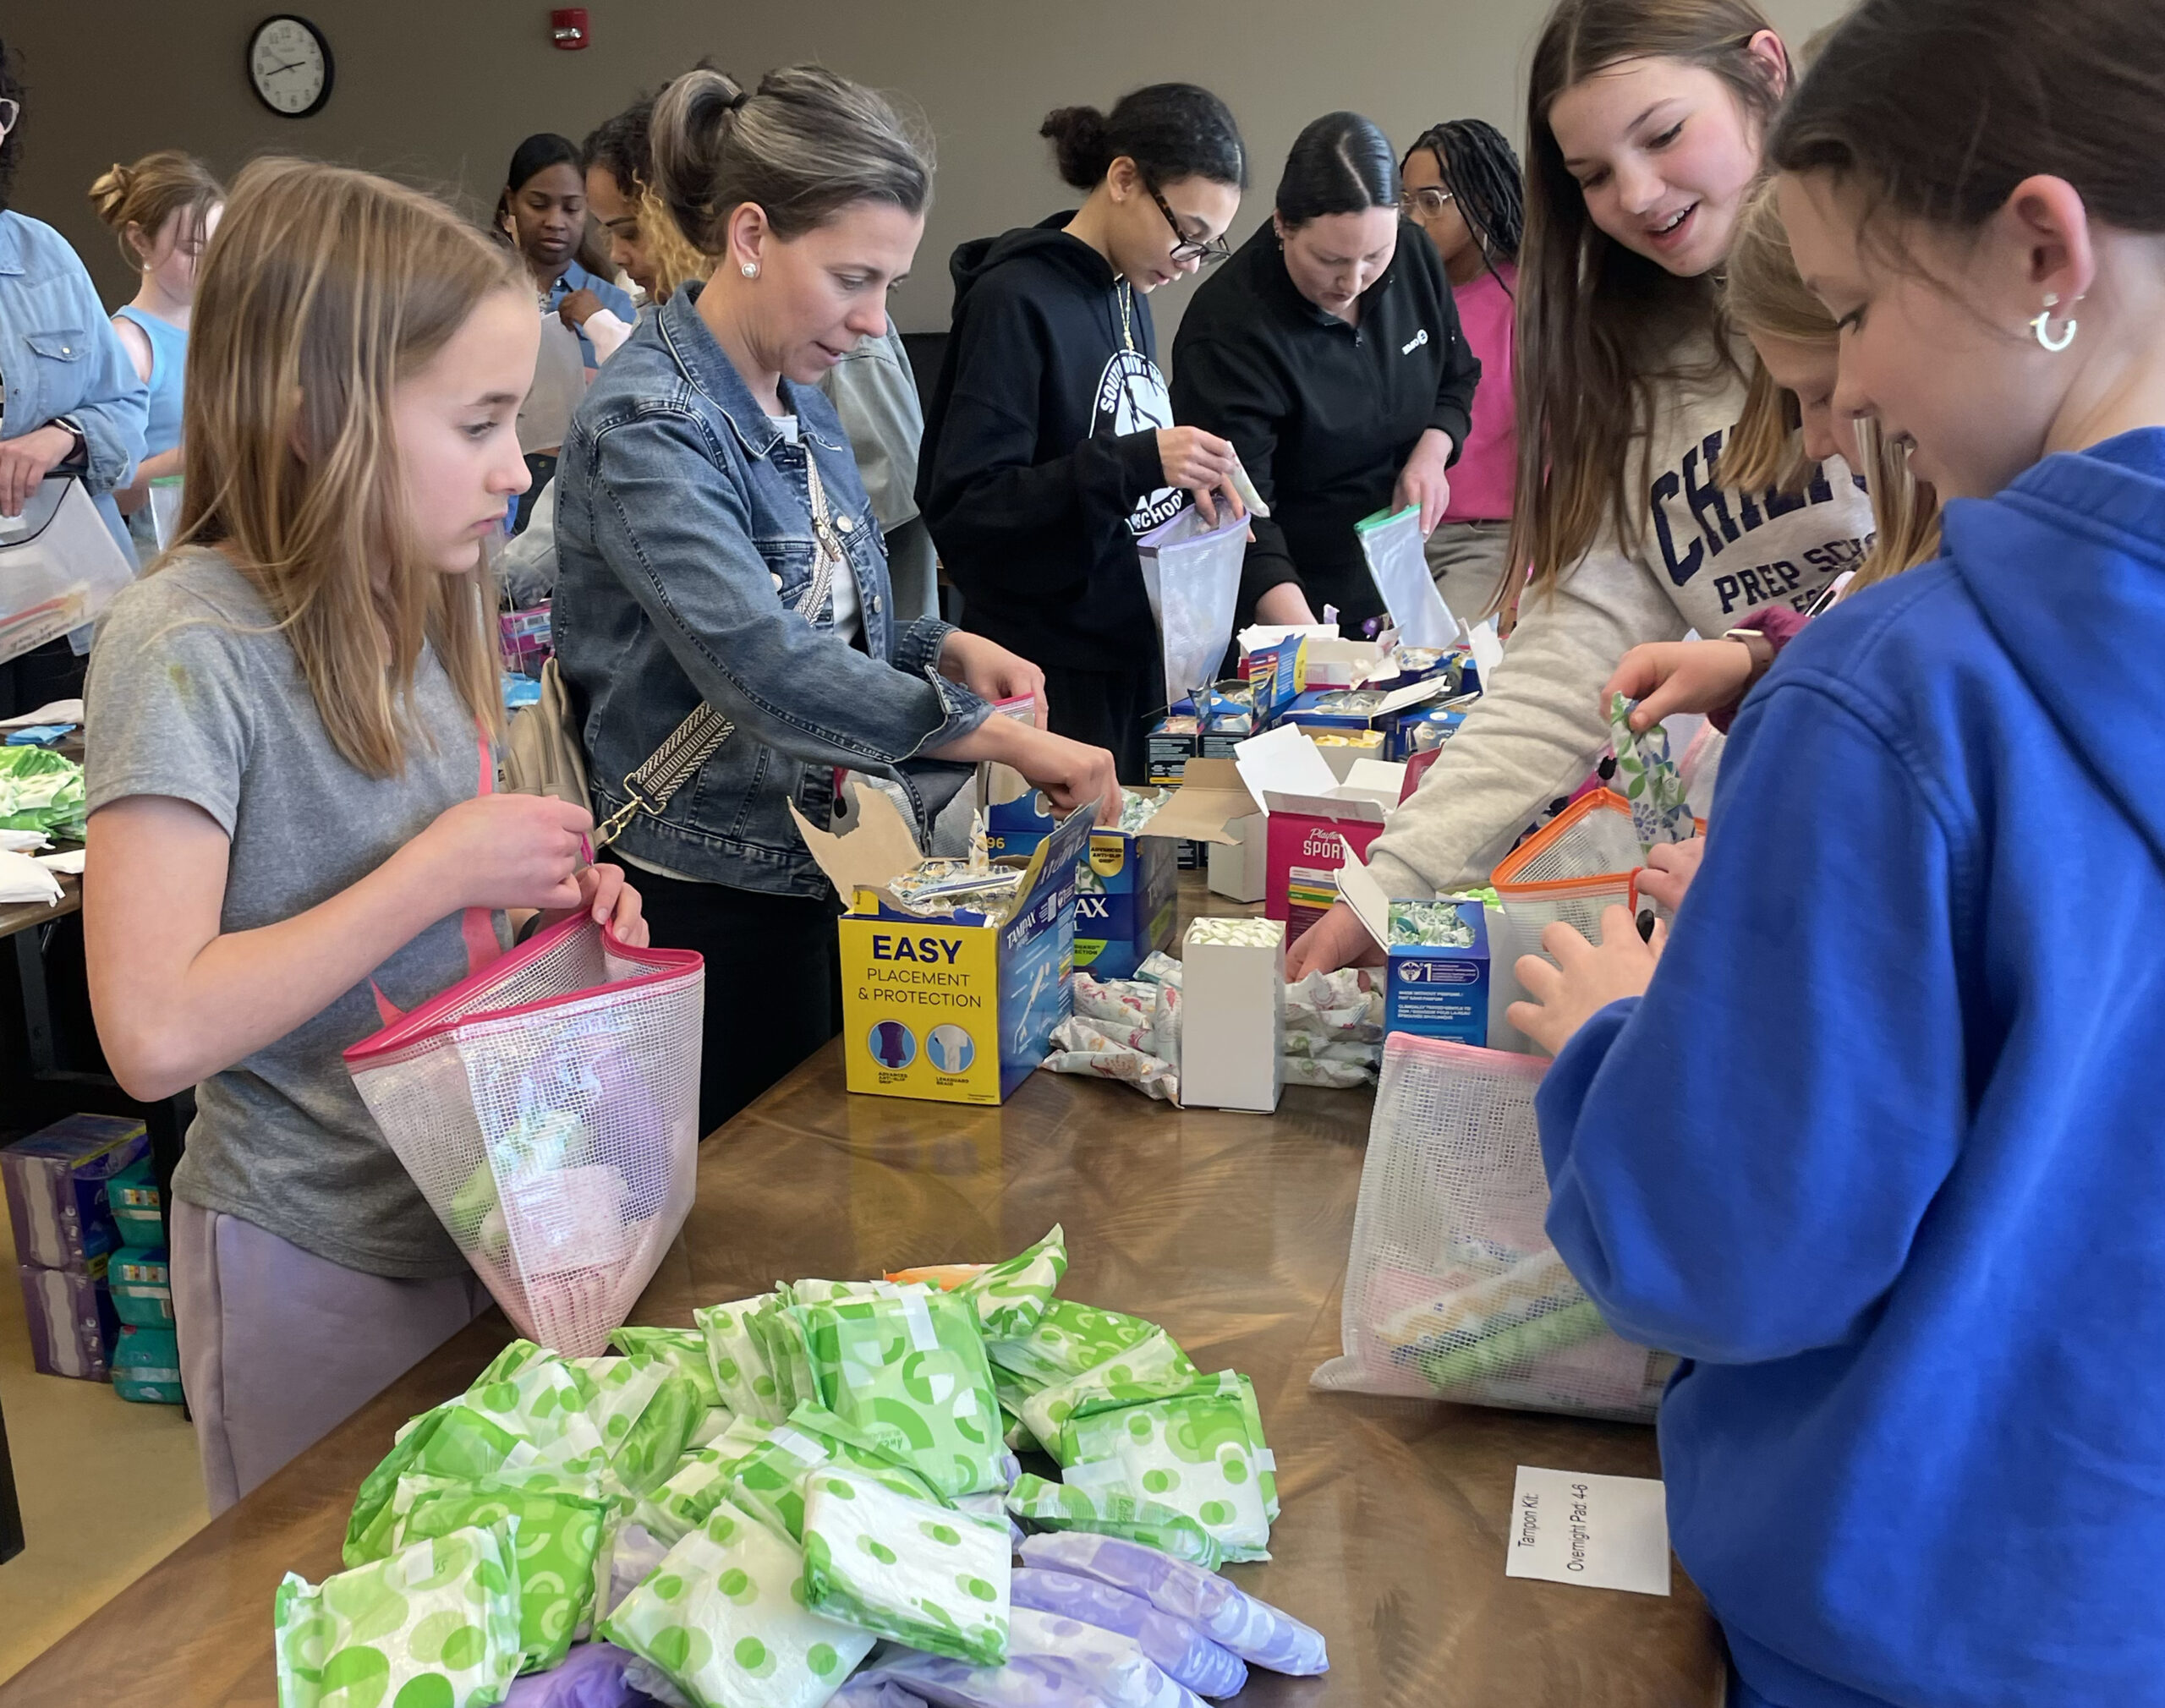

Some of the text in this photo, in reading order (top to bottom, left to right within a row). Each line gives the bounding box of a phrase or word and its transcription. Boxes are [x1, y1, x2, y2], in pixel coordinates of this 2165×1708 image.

[1713, 561, 1801, 615] PREP
[987, 835, 1006, 850] 96
[873, 934, 962, 965] EASY
[867, 967, 971, 988] PLACEMENT
[858, 987, 981, 1008] & PROTECTION
[1517, 1492, 1540, 1547] Tampon Kit:
[1566, 1483, 1590, 1572] Overnight Pad: 4-6
